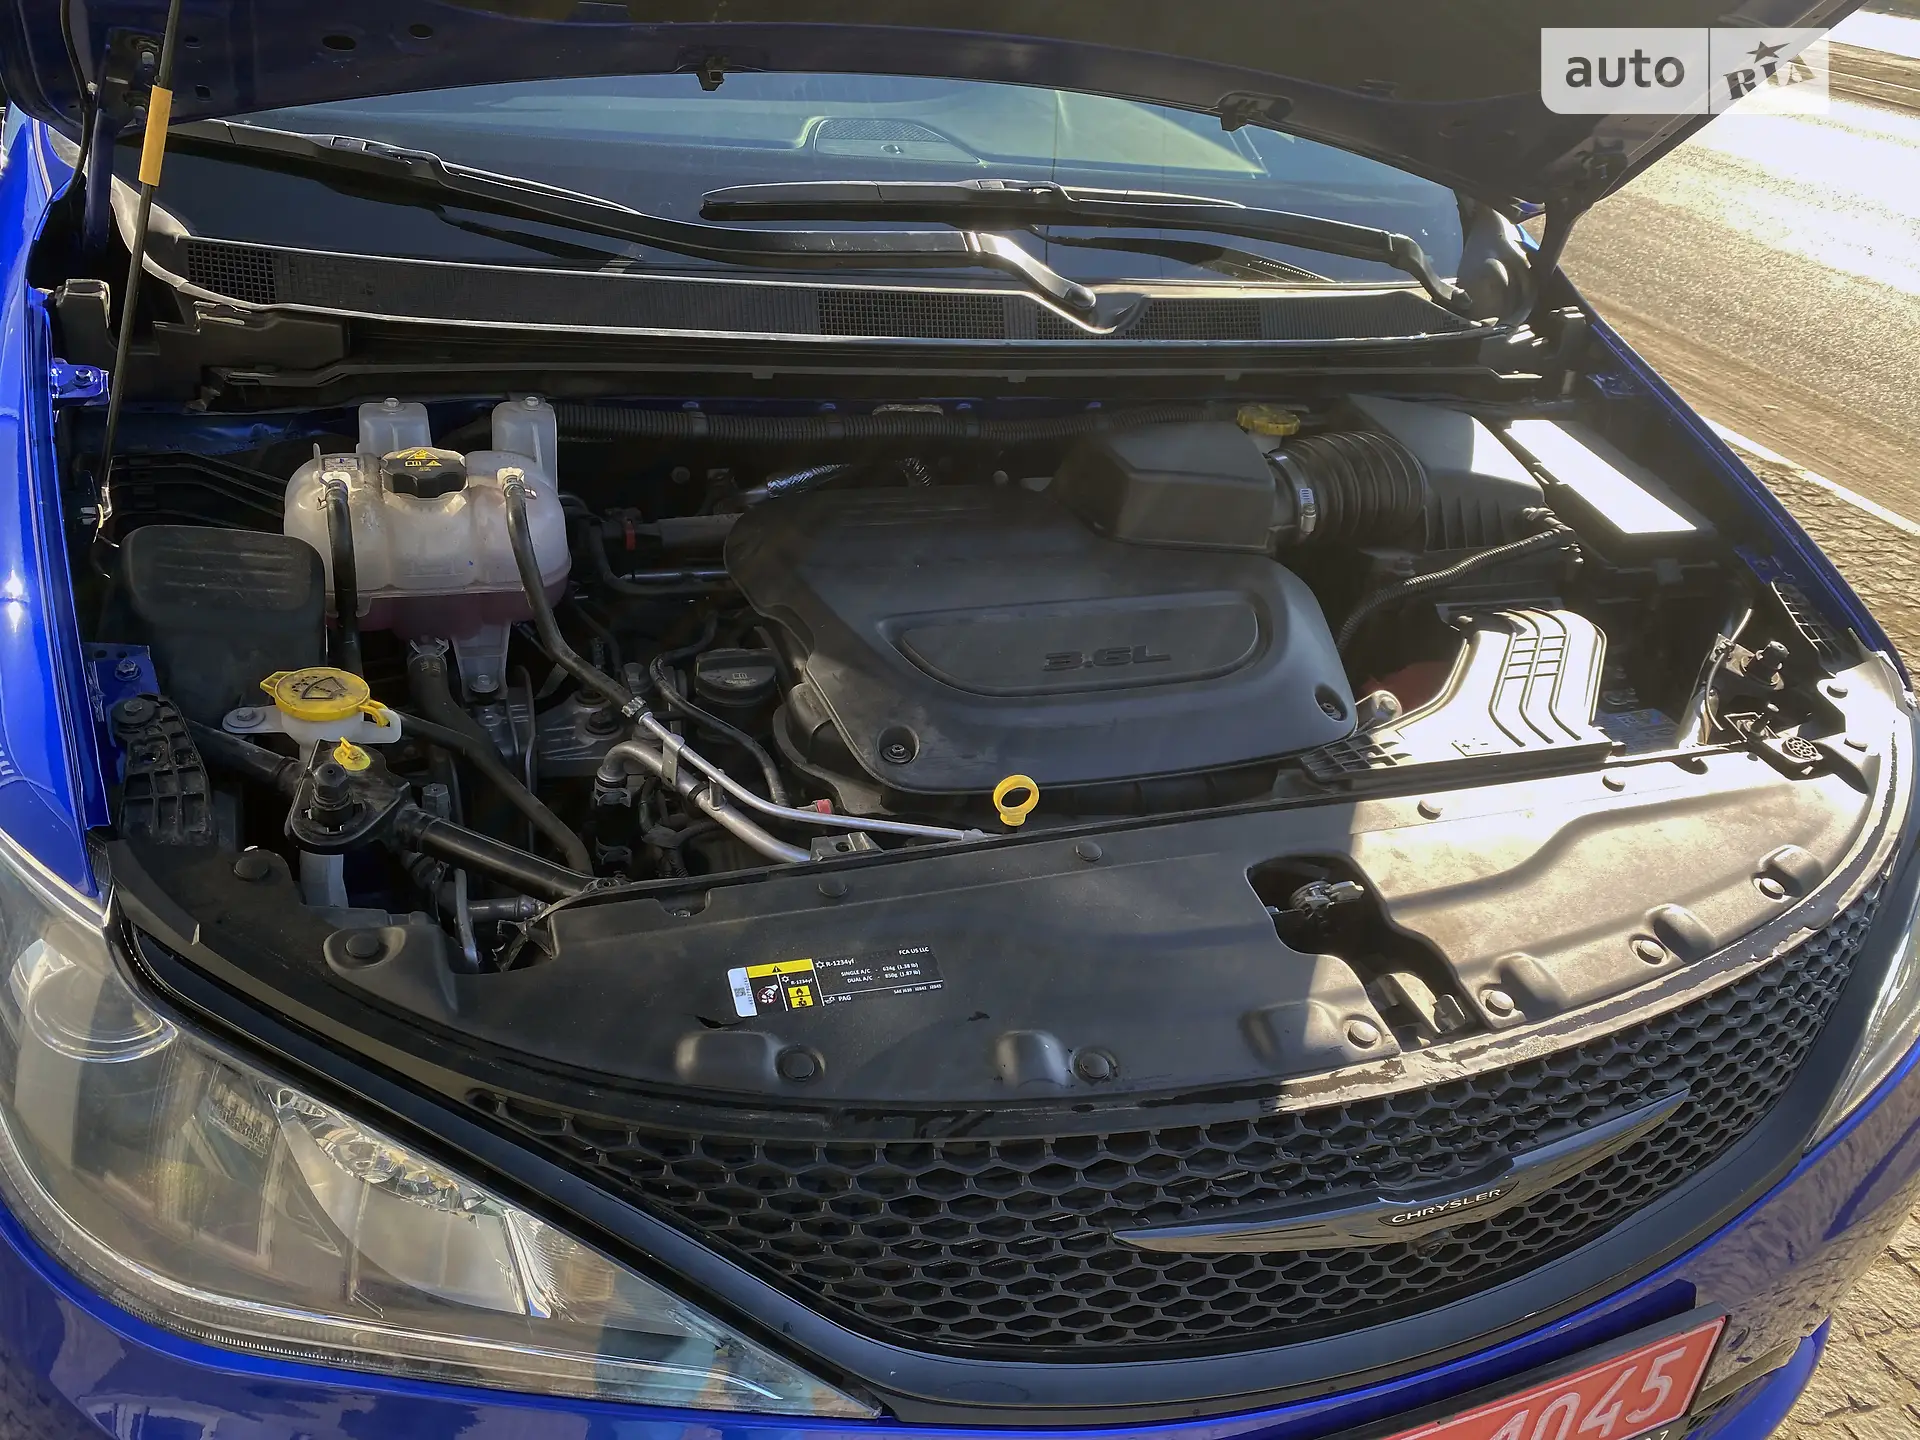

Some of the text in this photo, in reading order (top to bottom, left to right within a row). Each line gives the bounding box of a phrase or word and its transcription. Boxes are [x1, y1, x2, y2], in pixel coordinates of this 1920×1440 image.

[1042, 645, 1172, 671] 3.6L
[825, 958, 855, 967] R-1234yf
[840, 969, 860, 977] SINGLE
[1391, 1189, 1501, 1223] CHRYSLER
